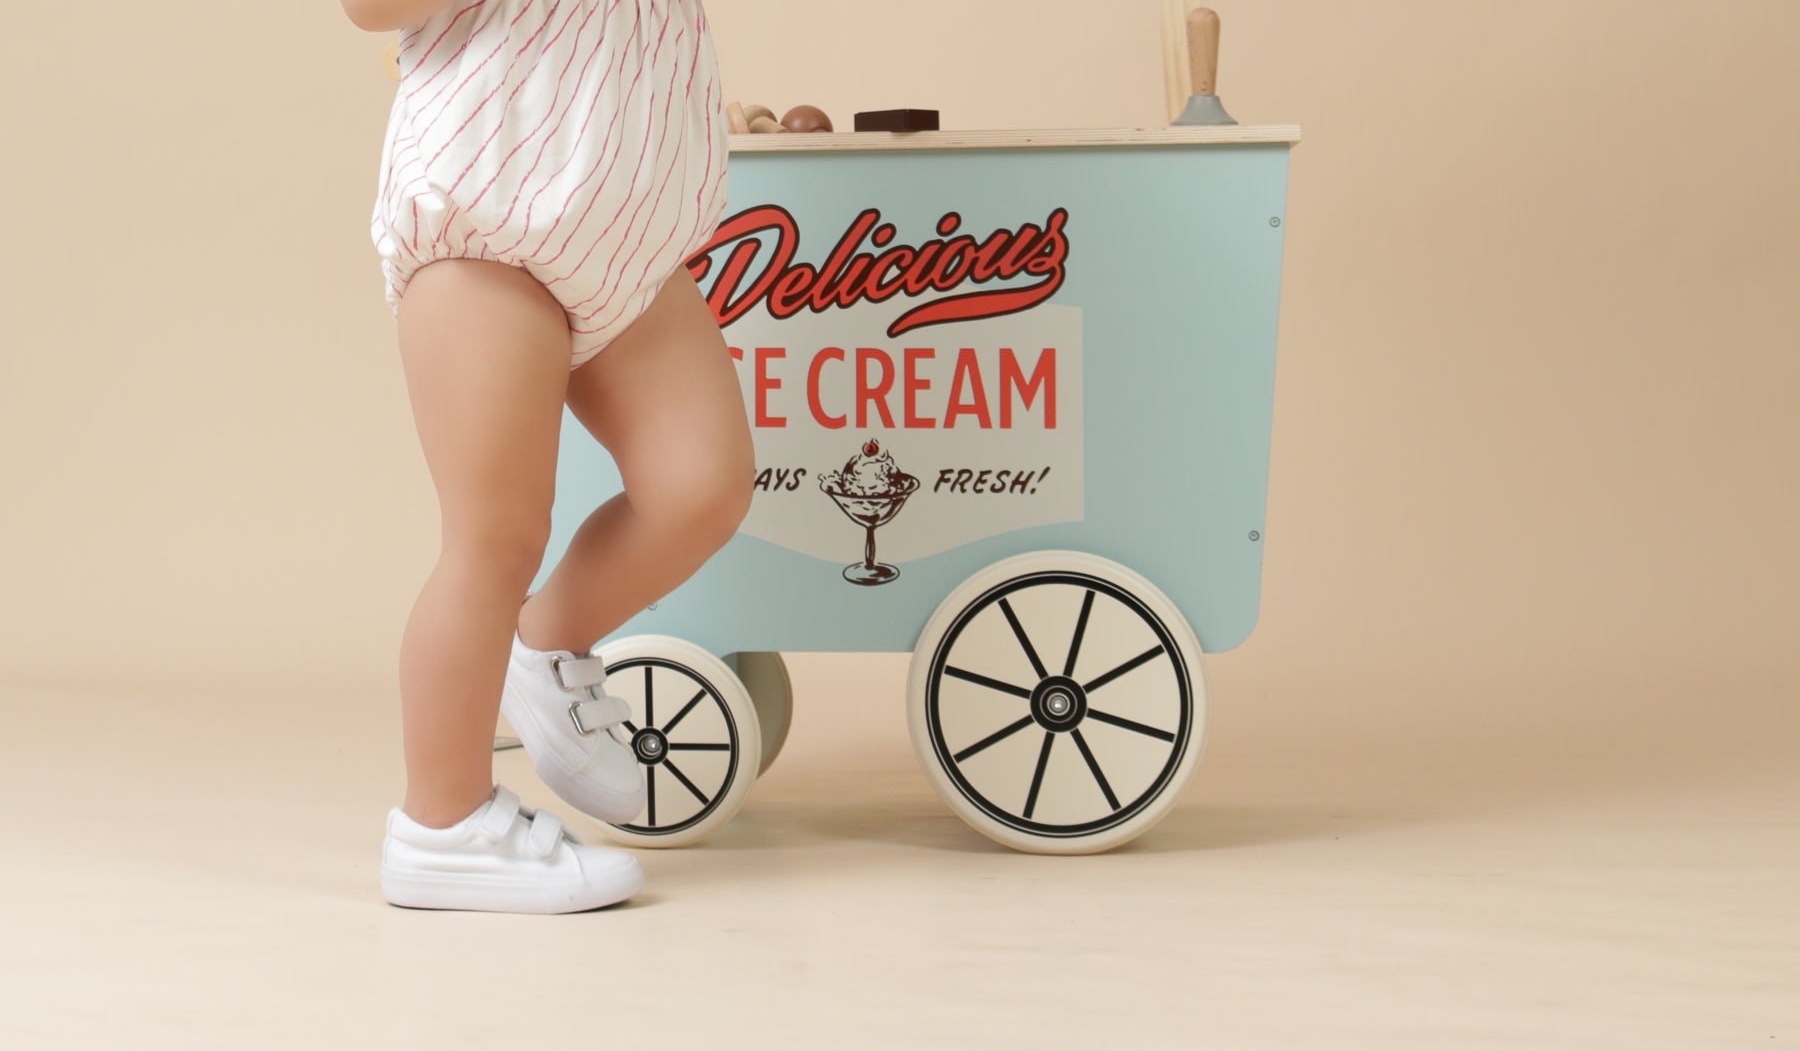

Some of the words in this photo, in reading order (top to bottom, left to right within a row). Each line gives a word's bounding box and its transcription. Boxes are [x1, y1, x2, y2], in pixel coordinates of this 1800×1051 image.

[685, 203, 1069, 338] Delicious
[806, 346, 1057, 429] CREAM
[753, 467, 807, 492] AYS
[933, 466, 1051, 495] FRESH!
